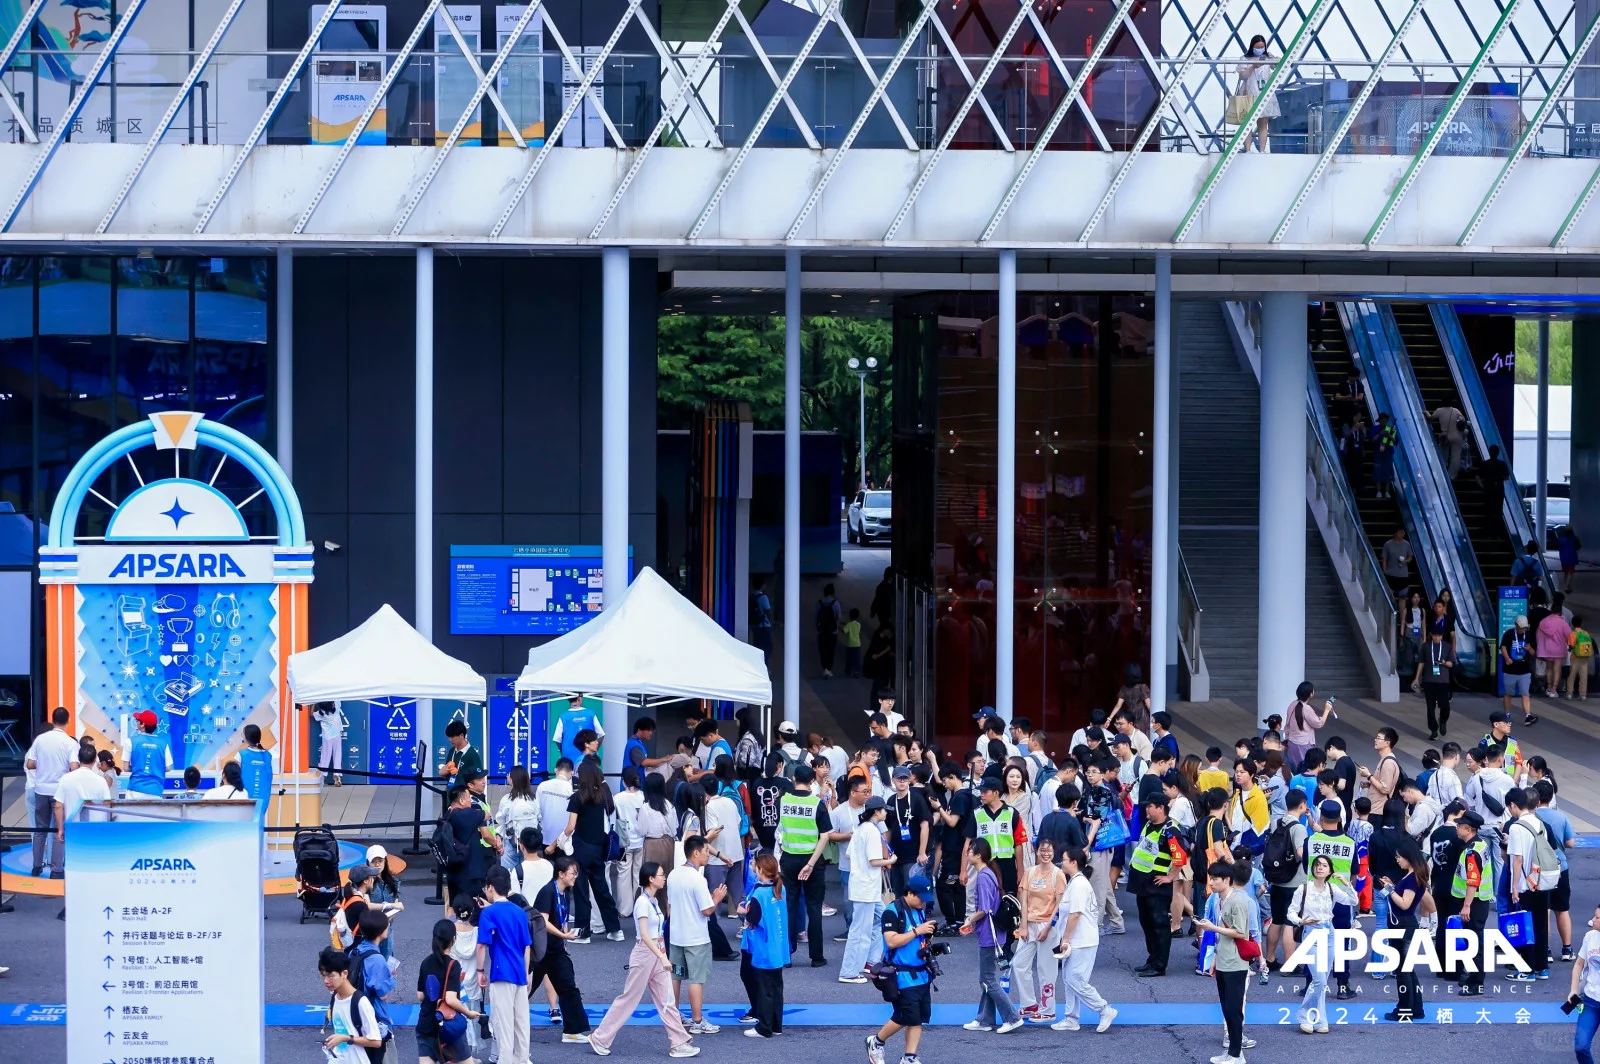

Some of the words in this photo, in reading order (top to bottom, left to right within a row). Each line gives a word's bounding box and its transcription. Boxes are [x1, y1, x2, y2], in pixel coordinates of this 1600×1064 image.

[503, 15, 523, 23] 元气森
[333, 94, 366, 102] APSARA
[109, 553, 246, 578] APSARA
[174, 779, 181, 789] 3
[782, 805, 813, 817] 安保集团
[1312, 842, 1351, 857] 安保集团
[130, 858, 196, 871] APSARA
[122, 906, 149, 916] 主会场
[151, 907, 173, 915] A-2F
[122, 931, 185, 940] 并行话题与论坛
[187, 931, 223, 939] B-2F/3F
[122, 1005, 149, 1015] 栖友会
[122, 1031, 150, 1040] 云友会
